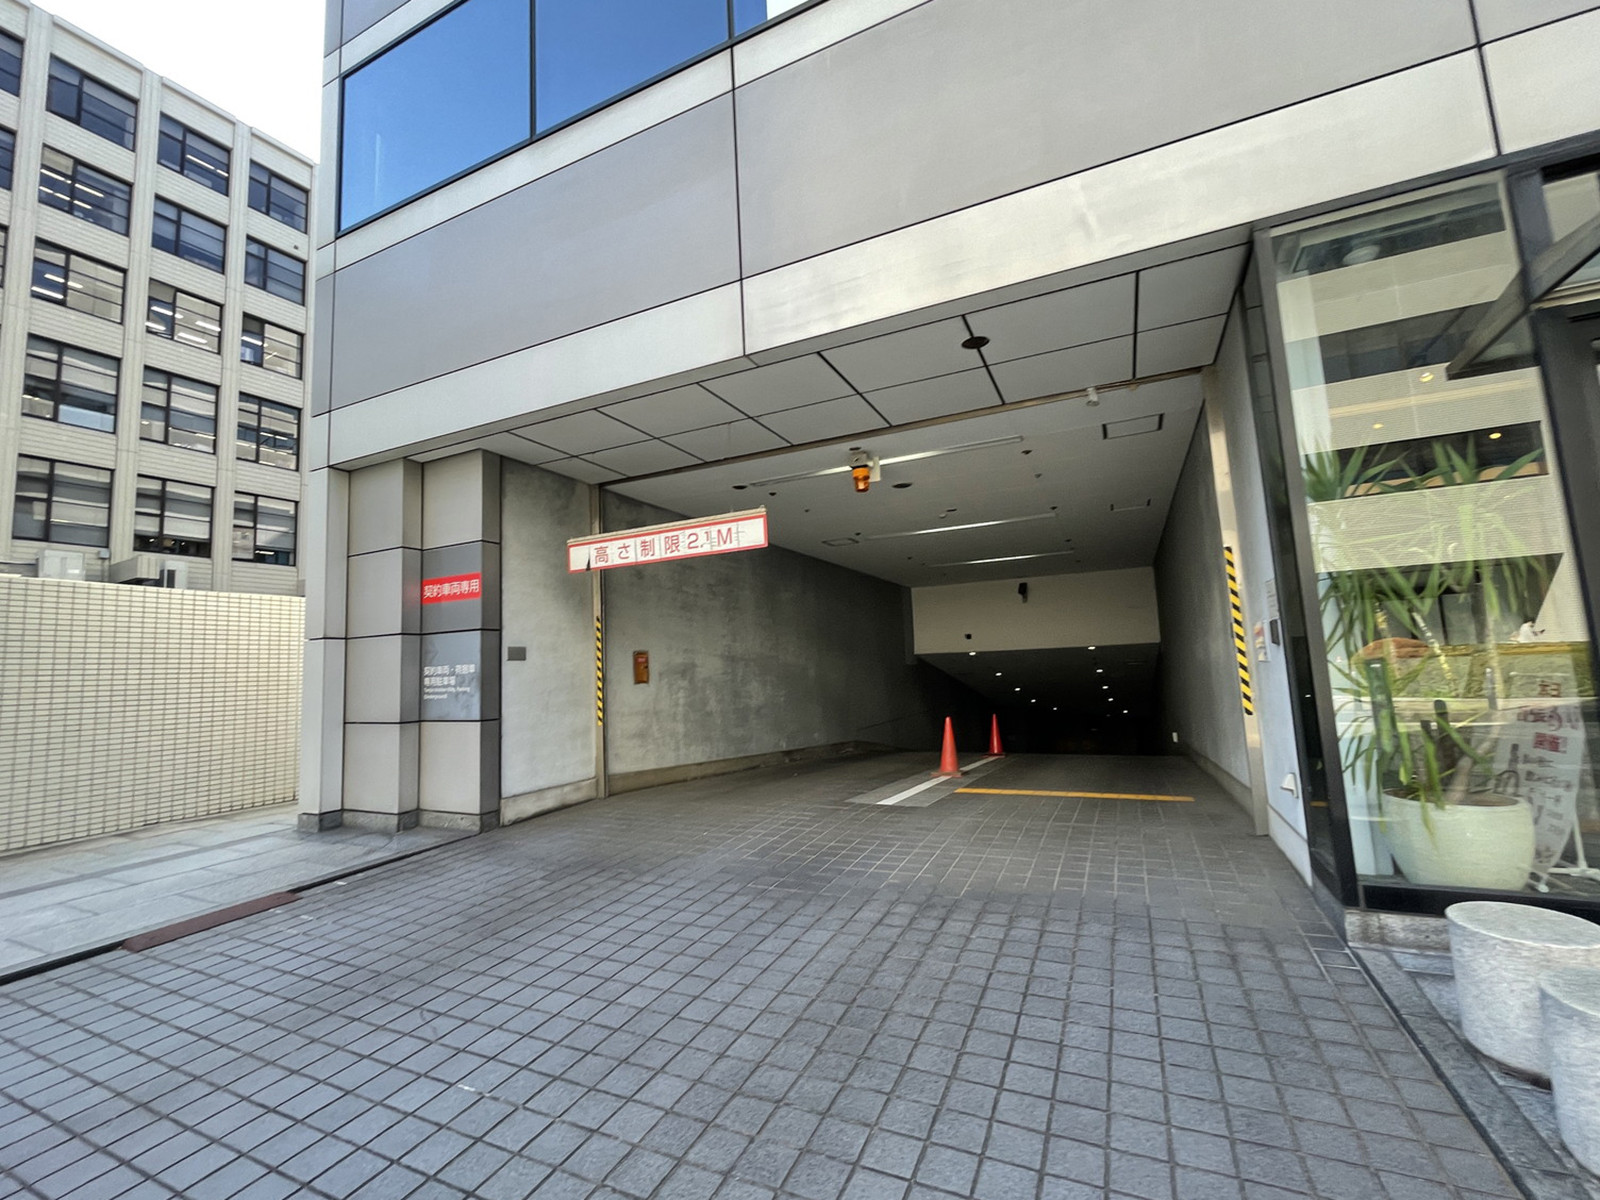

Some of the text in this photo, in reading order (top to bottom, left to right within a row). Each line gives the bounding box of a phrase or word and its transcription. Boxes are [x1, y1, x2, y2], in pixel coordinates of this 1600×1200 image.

[423, 579, 480, 599] 契約車両専用
